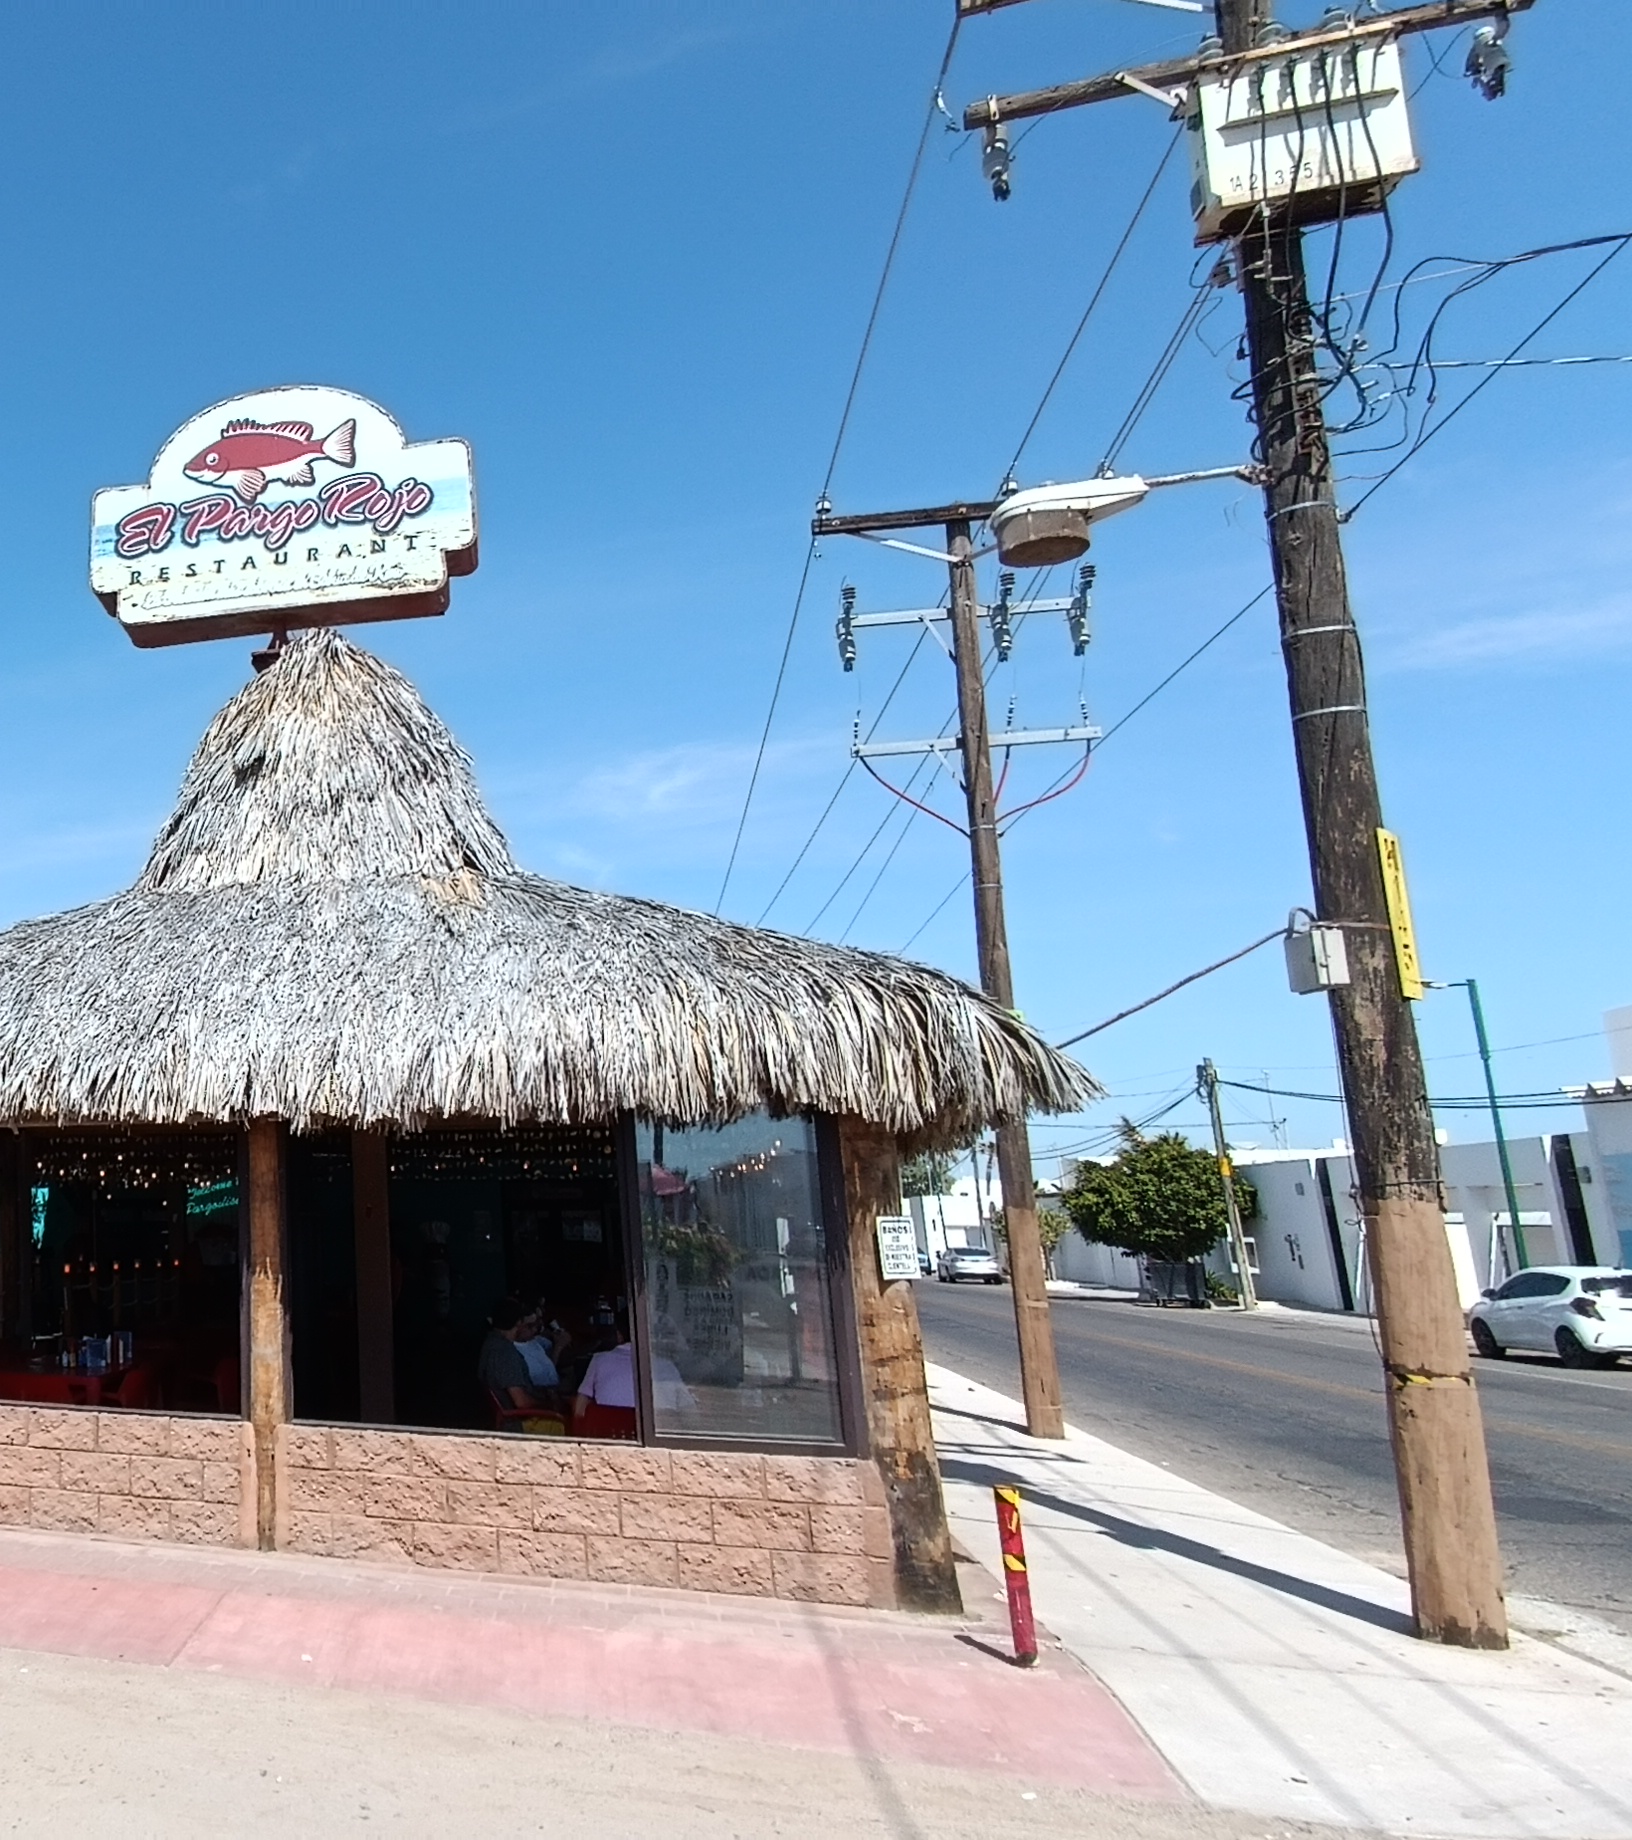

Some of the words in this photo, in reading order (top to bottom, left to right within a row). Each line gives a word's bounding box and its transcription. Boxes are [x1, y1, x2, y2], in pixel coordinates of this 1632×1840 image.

[115, 502, 176, 559] El
[179, 493, 320, 551] Pargo
[317, 471, 434, 536] Rojo
[128, 534, 420, 586] RESTAURANT
